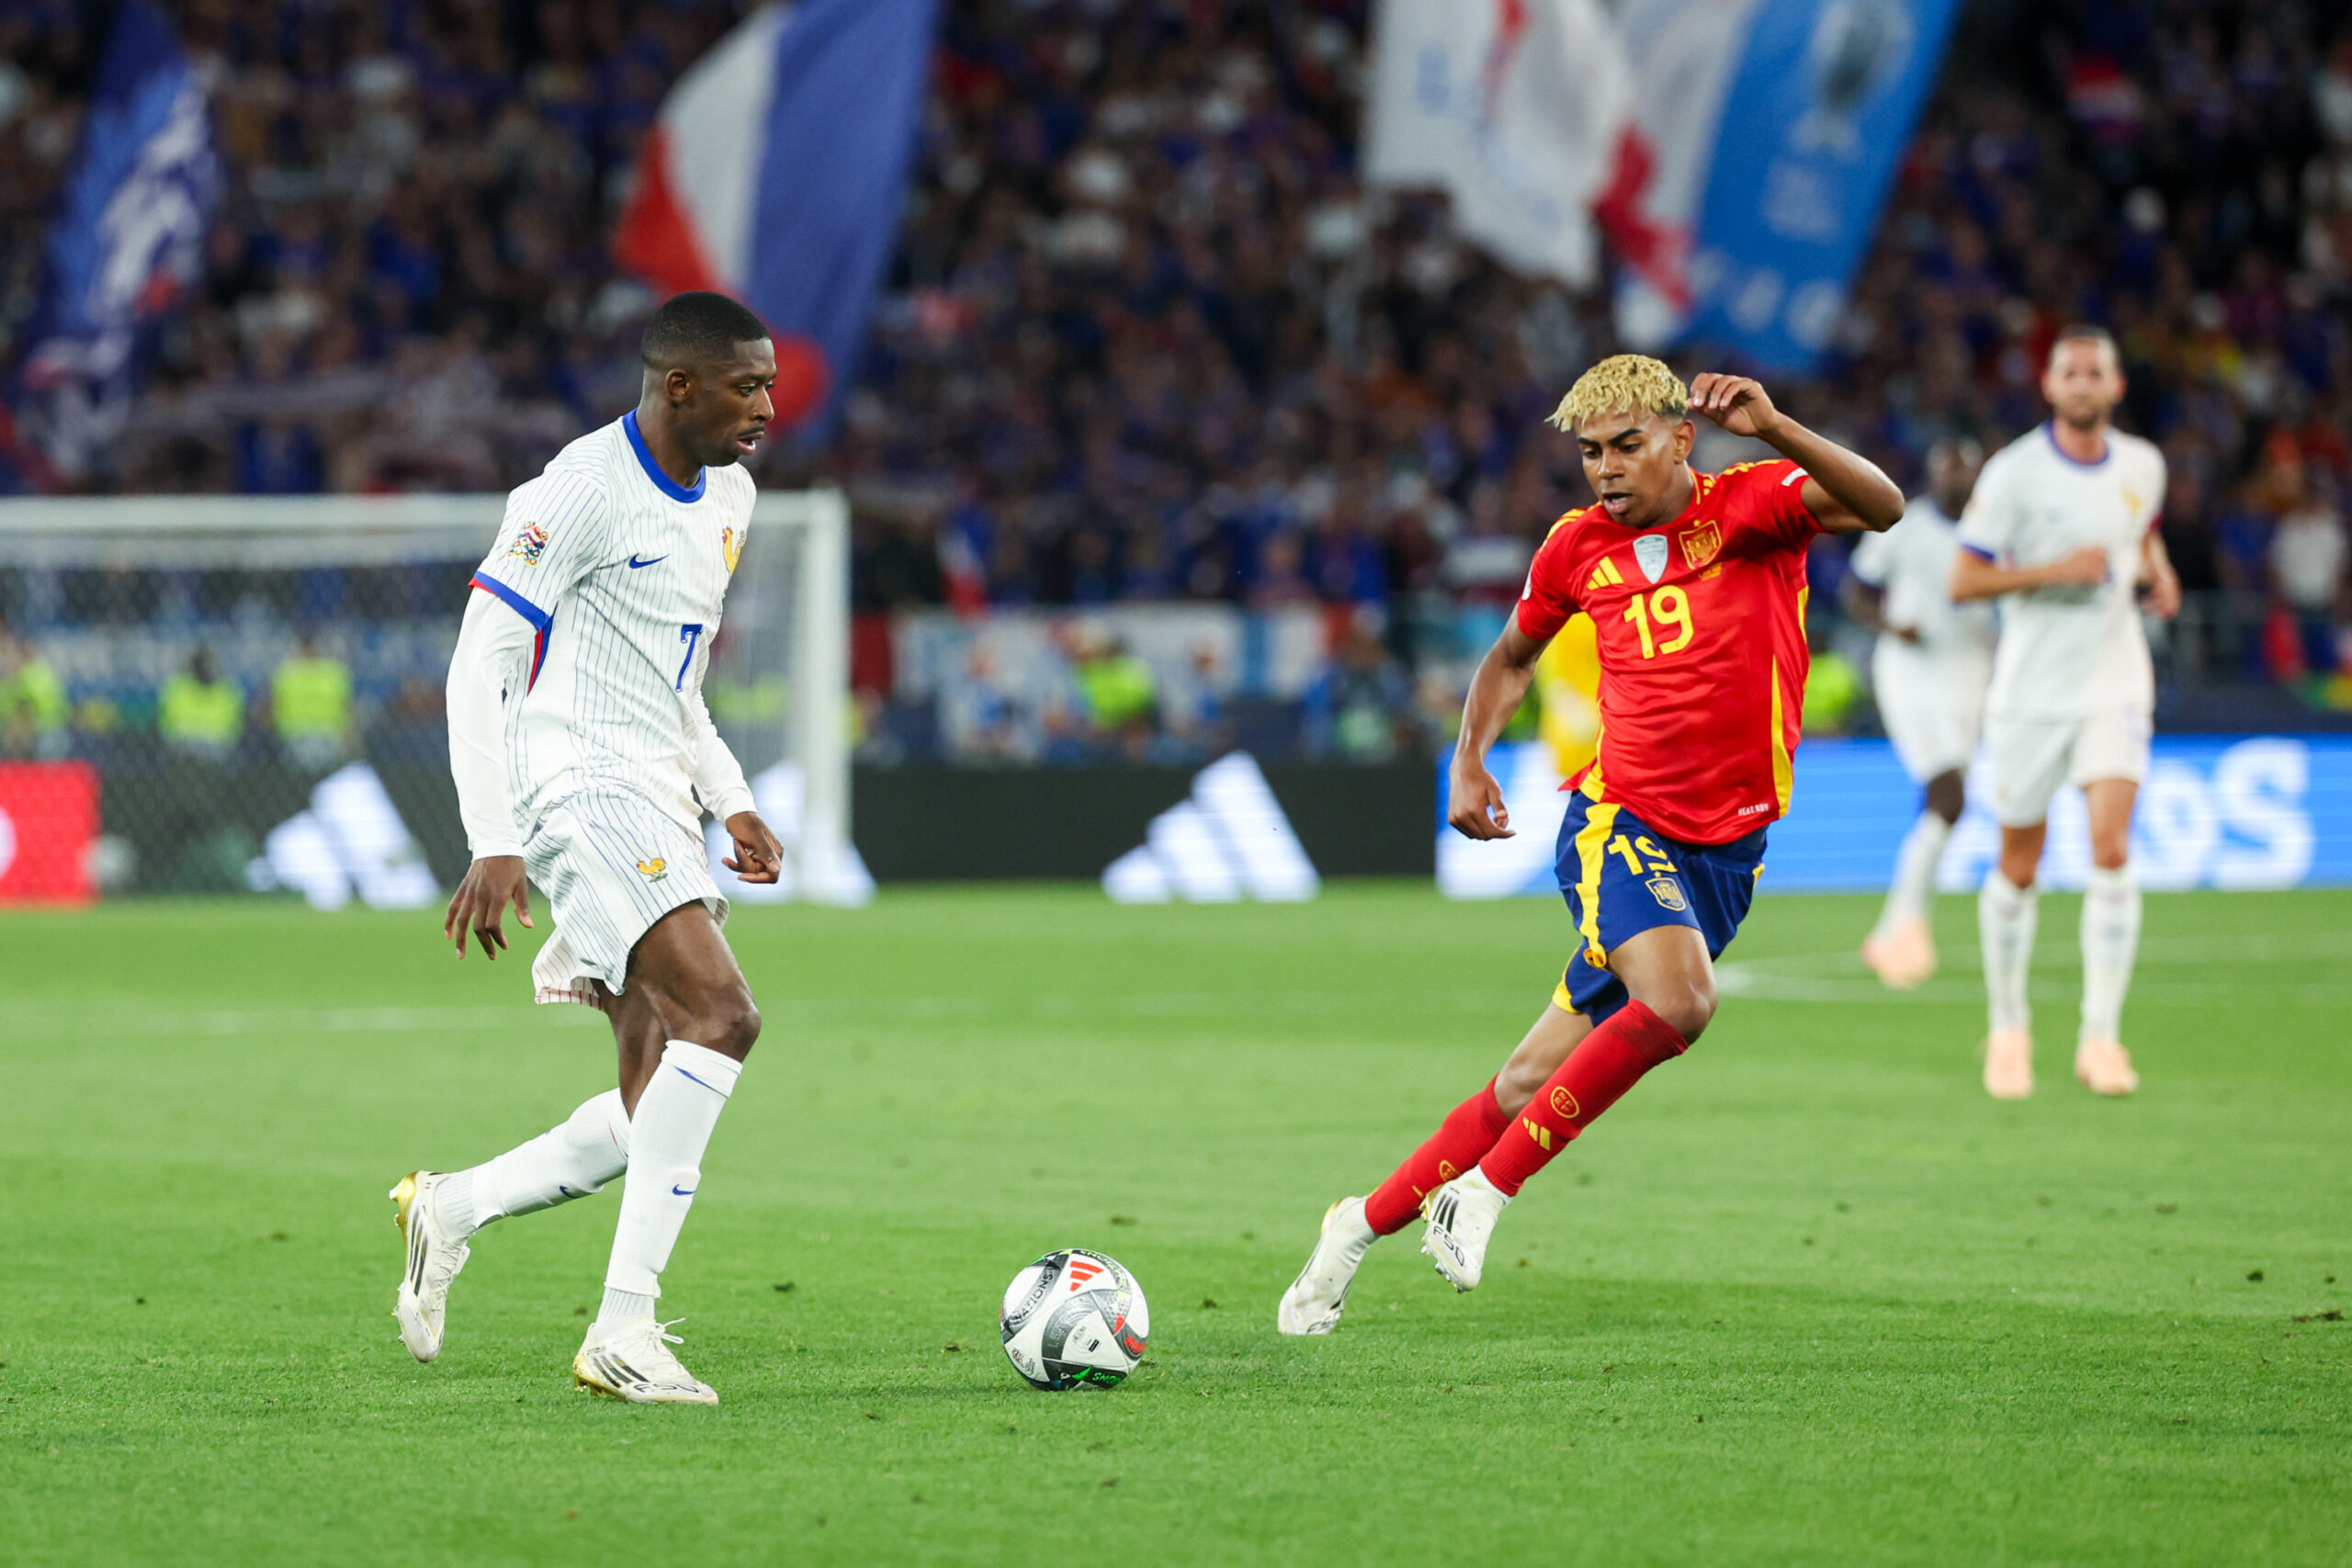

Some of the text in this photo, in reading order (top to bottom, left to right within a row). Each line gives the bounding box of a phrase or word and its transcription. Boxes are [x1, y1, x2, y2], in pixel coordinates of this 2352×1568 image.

[1623, 584, 1694, 660] 19
[675, 624, 704, 693] 7
[1607, 834, 1679, 875] 19
[1013, 1272, 1054, 1321] NATIONS
